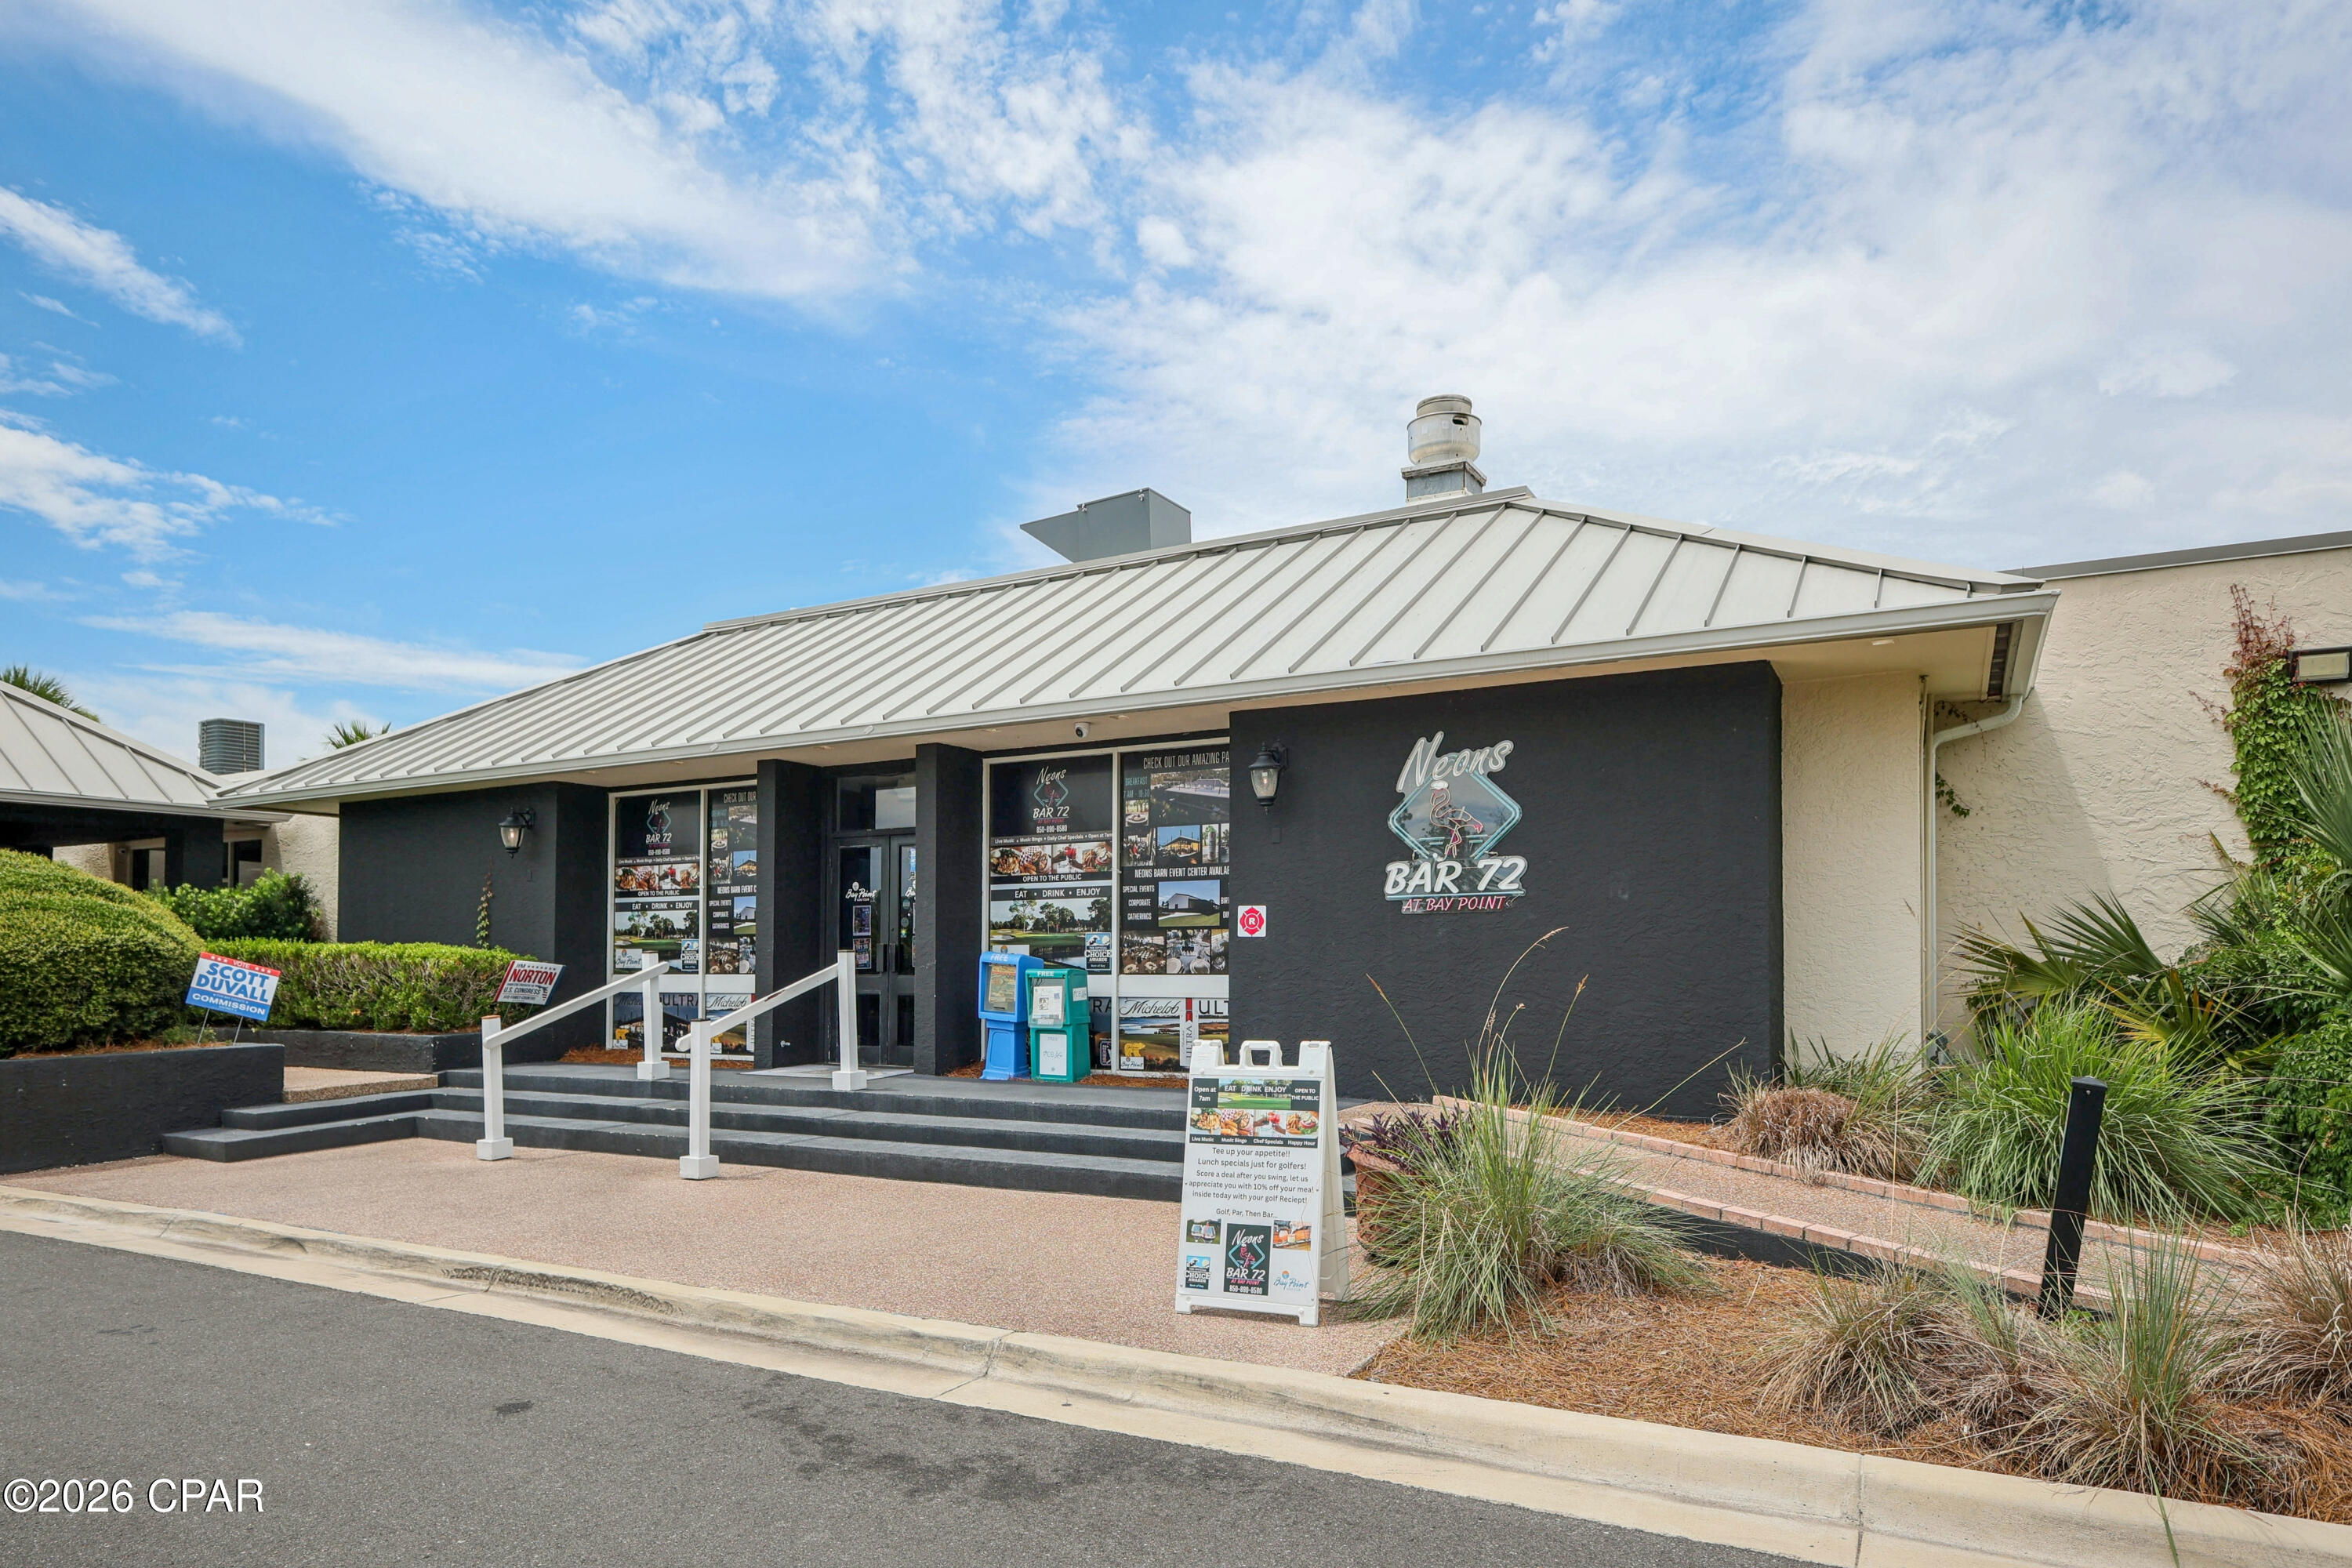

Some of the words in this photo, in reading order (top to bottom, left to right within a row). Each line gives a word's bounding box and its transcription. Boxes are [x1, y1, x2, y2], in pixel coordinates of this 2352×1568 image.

[1143, 757, 1162, 769] CHECK
[1164, 756, 1176, 768] OUT
[1178, 754, 1190, 767] OUR
[1192, 752, 1220, 766] AMAZING
[1396, 731, 1514, 793] Neons
[1036, 766, 1066, 785] Neons
[1033, 808, 1054, 818] BAR
[1057, 806, 1069, 817] 72
[646, 833, 661, 843] BAR
[662, 833, 672, 842] 72
[1134, 869, 1152, 878] NEONS
[1153, 868, 1167, 877] BARN
[1169, 867, 1185, 877] EVENT
[1187, 866, 1207, 876] CENTER
[1385, 860, 1463, 894] BAR
[1477, 858, 1526, 891] 72
[1042, 889, 1065, 898] DRINK
[1076, 887, 1101, 896] ENJOY
[1403, 898, 1423, 912] AT
[1426, 898, 1454, 911] BAY
[1457, 896, 1506, 910] POINT
[1084, 949, 1112, 958] CHOICE
[232, 960, 251, 969] VOTE
[206, 963, 270, 988] SCOTT
[509, 969, 557, 985] NORTON
[195, 974, 269, 1003] DUVALL
[192, 993, 266, 1015] COMMISSION
[1119, 1000, 1181, 1014] Michelob
[1250, 1160, 1265, 1169] just
[1268, 1174, 1288, 1182] swing,
[1213, 1192, 1232, 1200] today
[1279, 1196, 1307, 1204] Reciept!
[1232, 1229, 1264, 1245] Neons
[1185, 1270, 1211, 1279] CHOICE
[1226, 1267, 1248, 1279] BAR
[1252, 1269, 1265, 1280] 72
